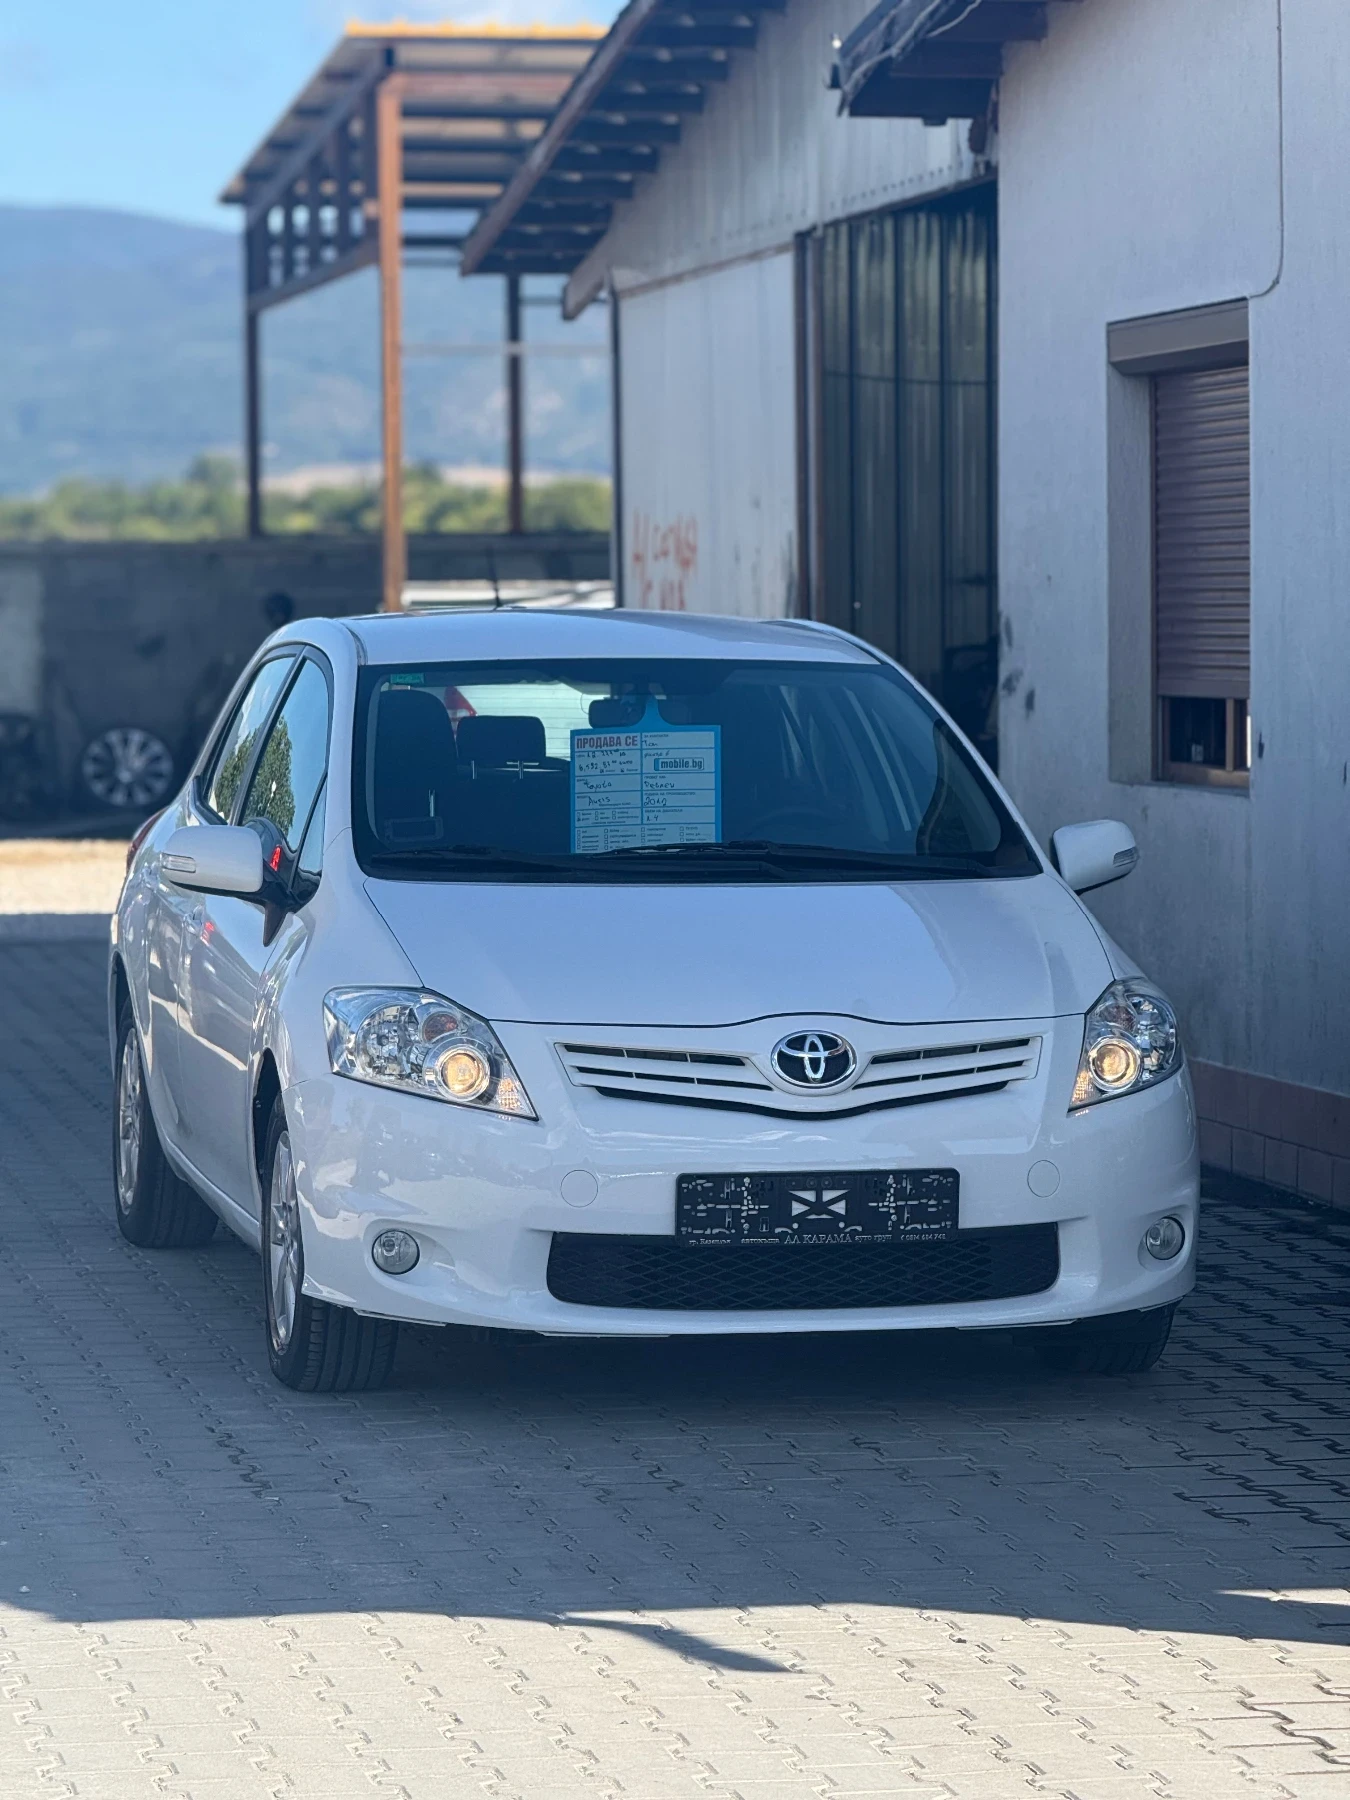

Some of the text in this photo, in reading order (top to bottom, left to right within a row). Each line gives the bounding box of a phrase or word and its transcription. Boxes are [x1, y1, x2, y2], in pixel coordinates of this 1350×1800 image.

[576, 735, 638, 749] ПРОДАВА СЕ
[660, 758, 703, 770] mobile.bg
[802, 1234, 853, 1244] КАРАМА
